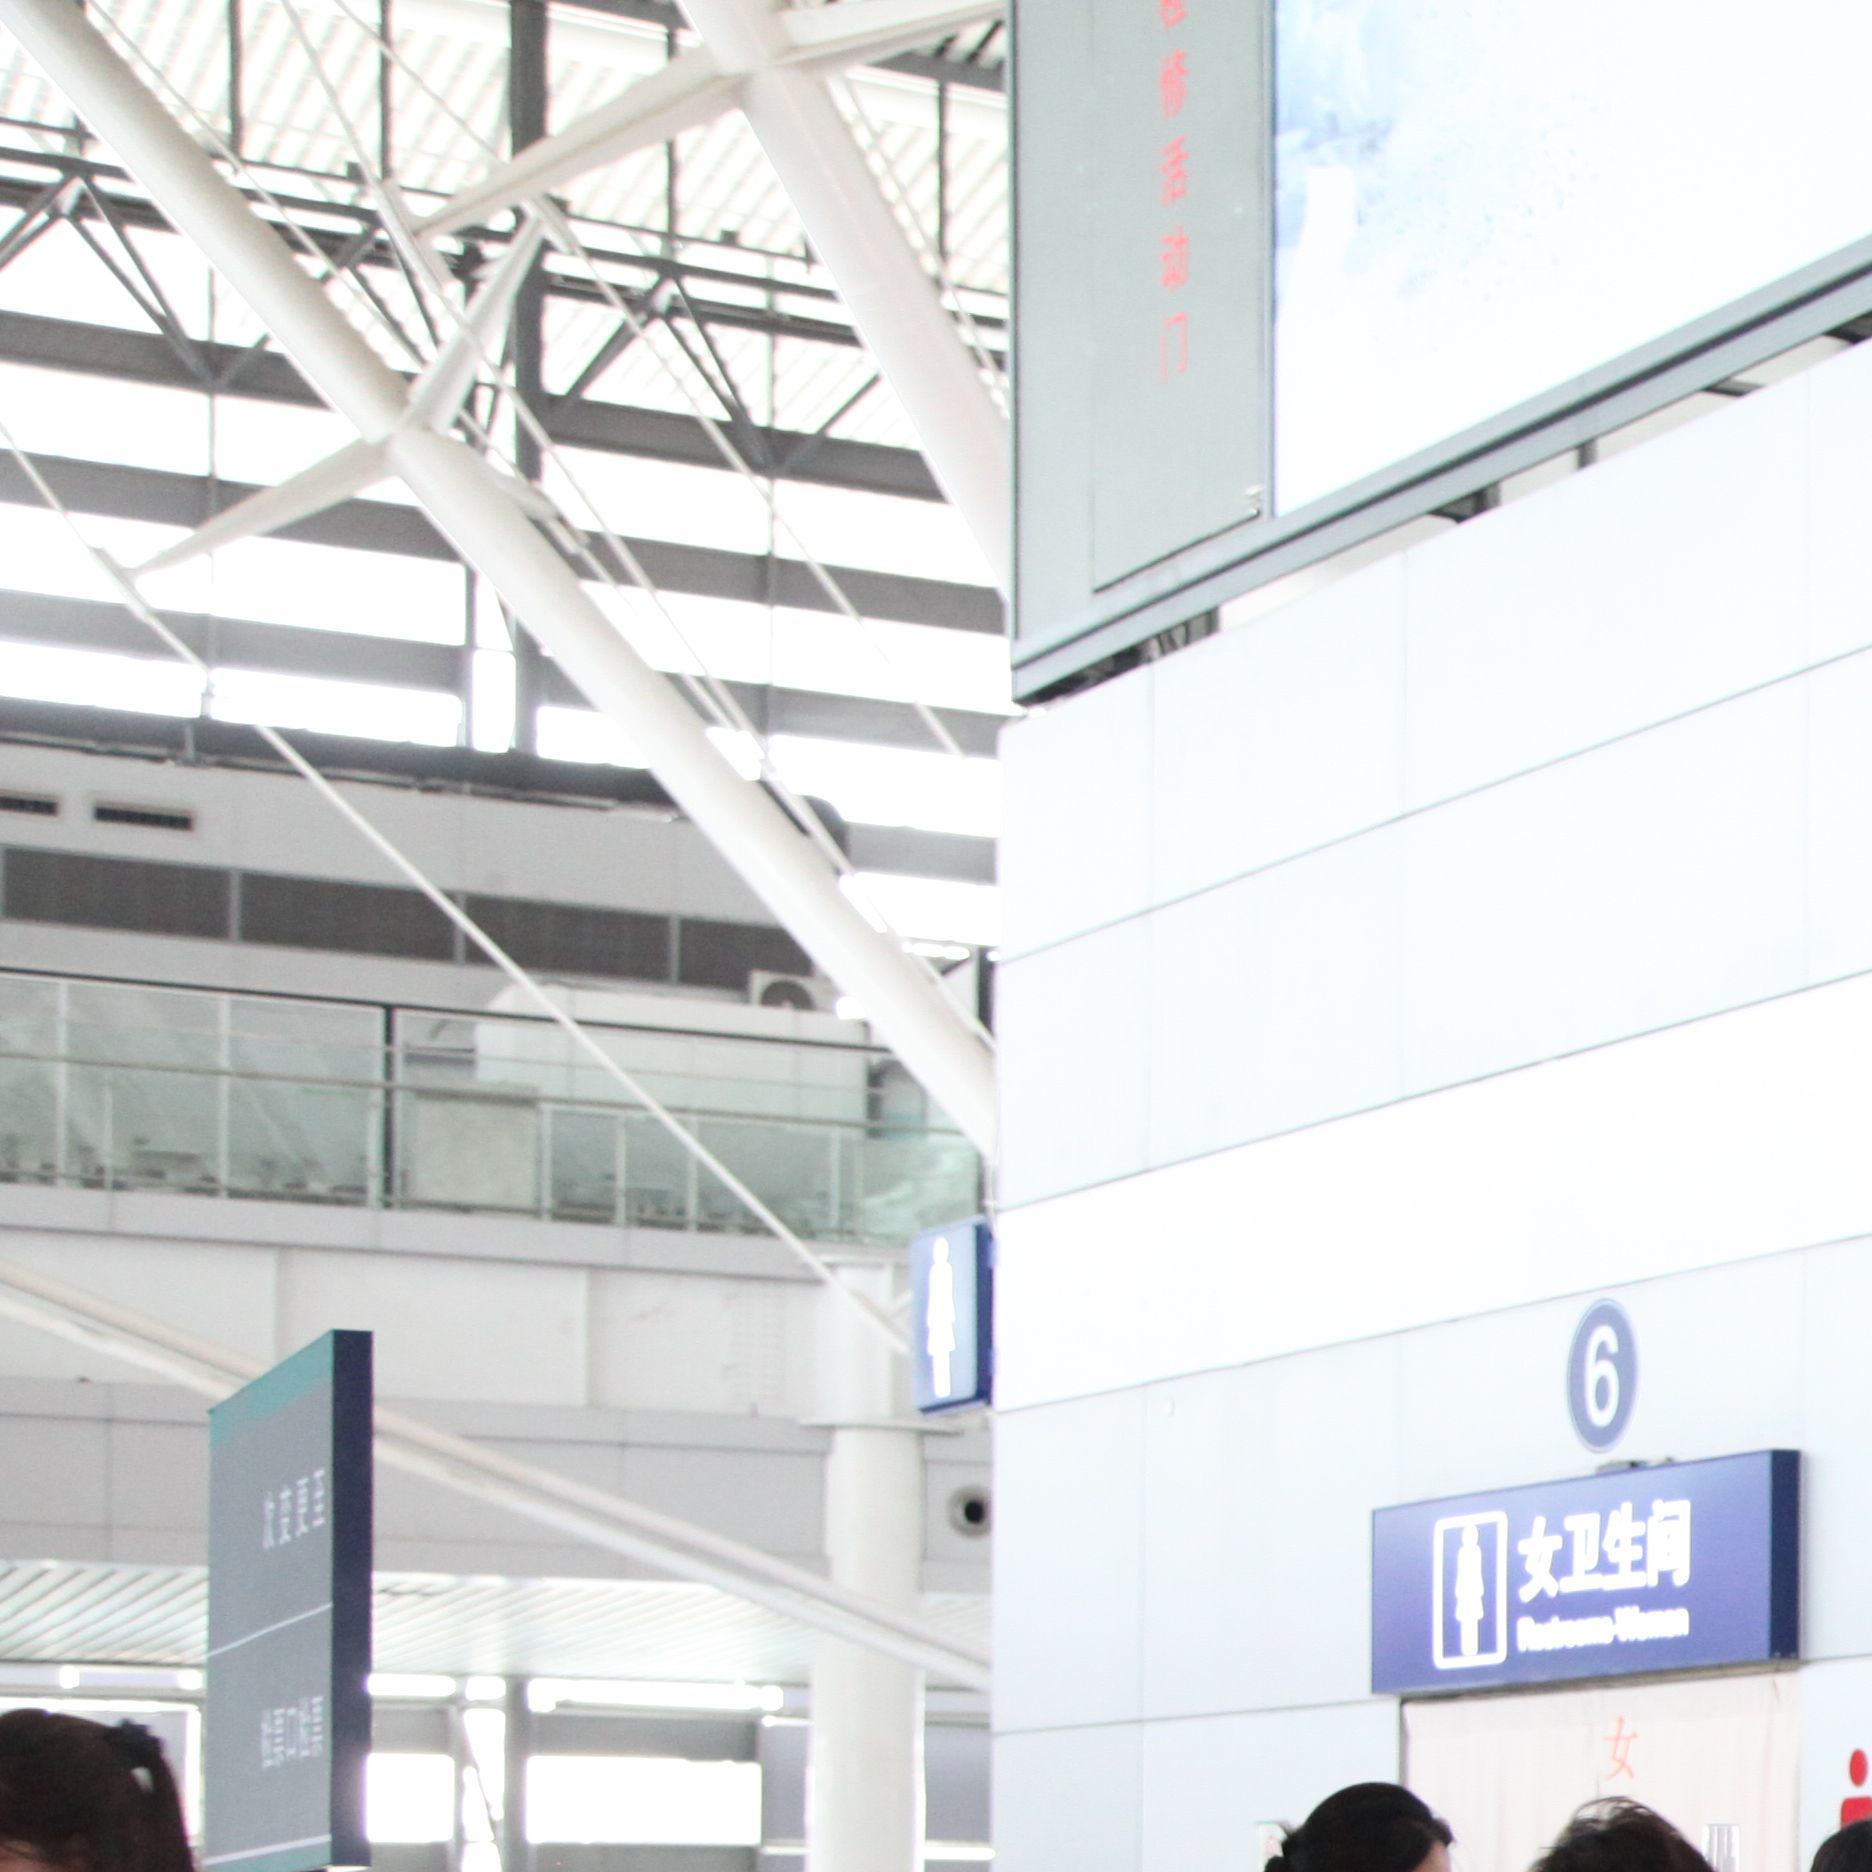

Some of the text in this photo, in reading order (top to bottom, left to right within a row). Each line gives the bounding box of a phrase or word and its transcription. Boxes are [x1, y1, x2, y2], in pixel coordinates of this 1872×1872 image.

[1583, 1324, 1620, 1429] 6
[1518, 1499, 1691, 1604] 女卫生间
[1603, 1715, 1638, 1780] 女
